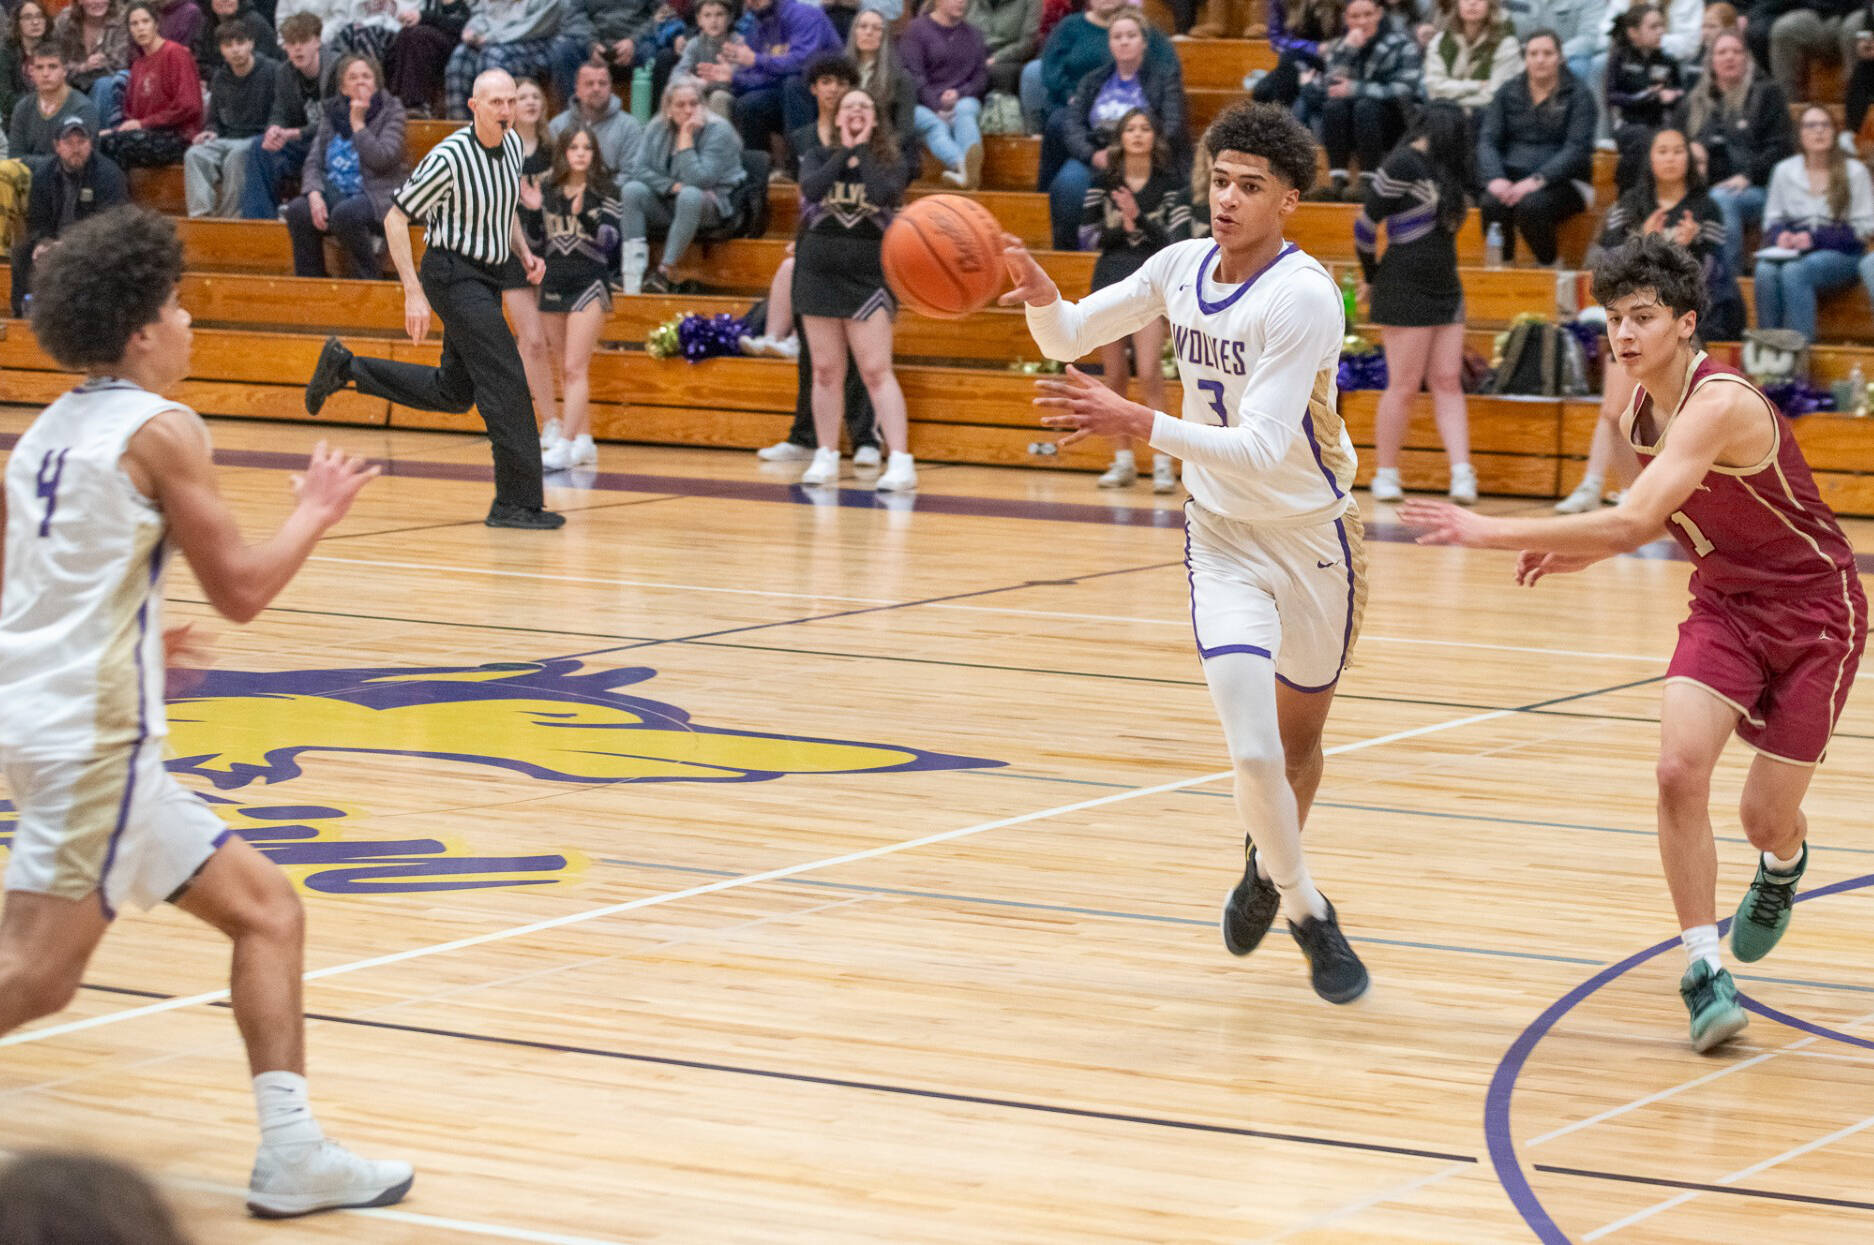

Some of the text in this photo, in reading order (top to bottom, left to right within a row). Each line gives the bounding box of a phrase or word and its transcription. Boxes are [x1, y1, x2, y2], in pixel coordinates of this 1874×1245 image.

[1172, 323, 1246, 376] WOLVES
[1197, 378, 1229, 427] 3
[36, 447, 72, 538] 4
[1670, 509, 1716, 558] 1
